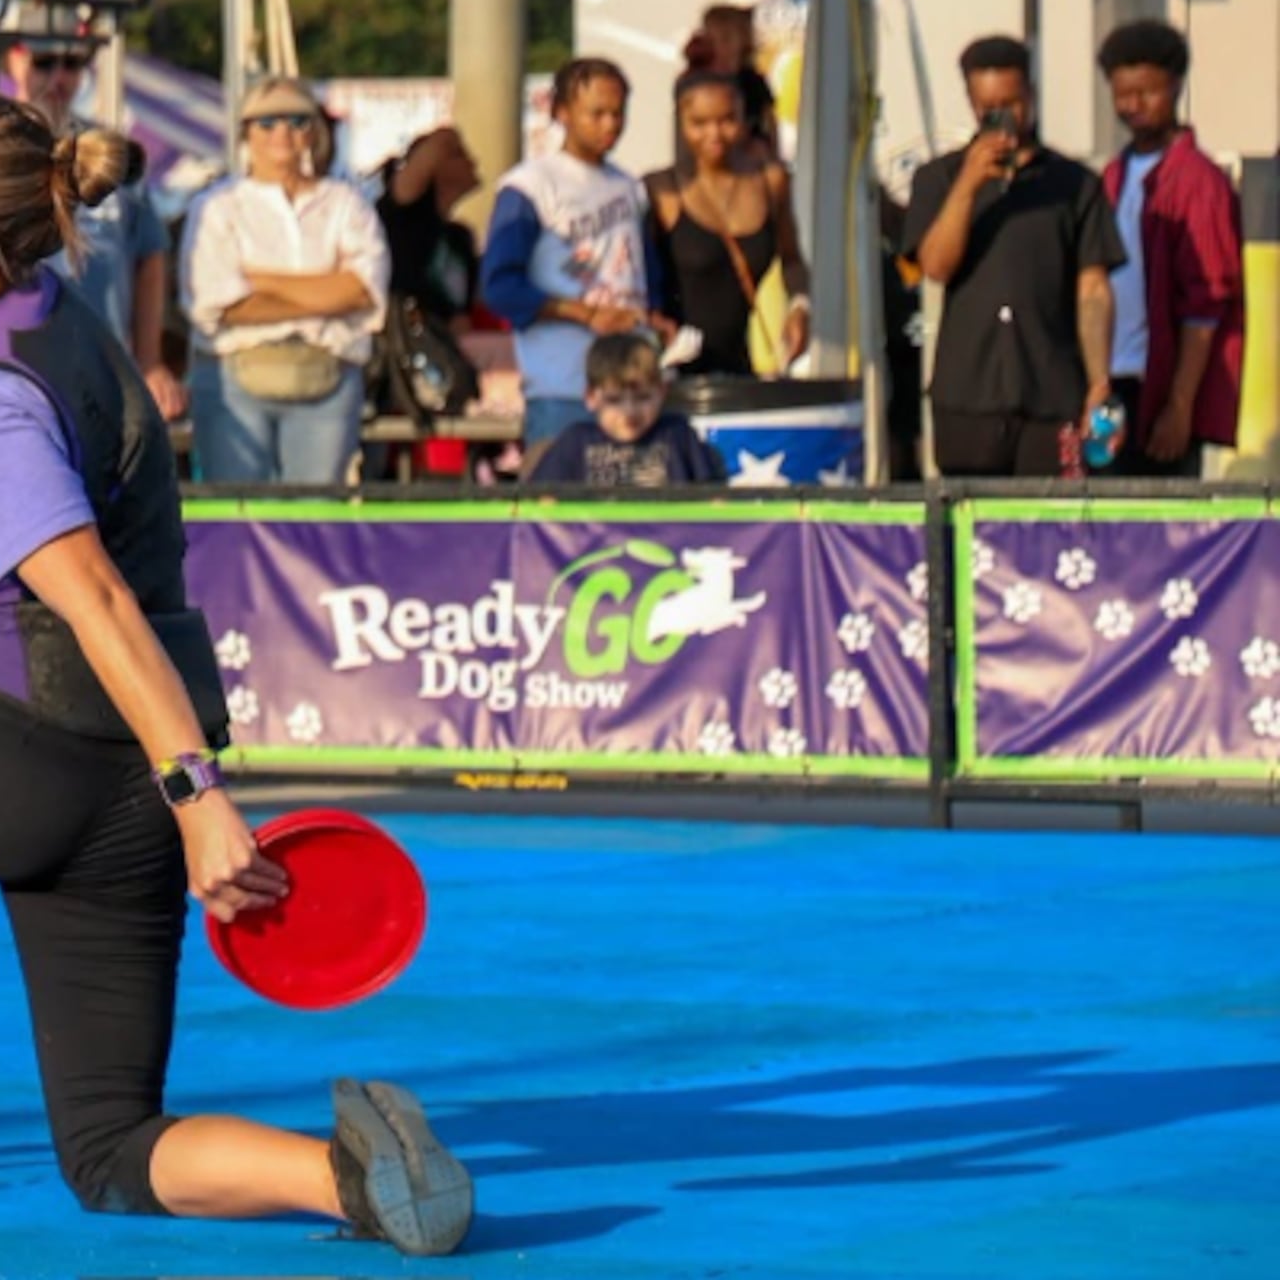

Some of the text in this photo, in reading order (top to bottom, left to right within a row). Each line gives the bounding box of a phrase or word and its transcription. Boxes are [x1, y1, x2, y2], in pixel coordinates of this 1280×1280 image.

[318, 579, 564, 671] Ready
[418, 649, 629, 711] Dog Show
